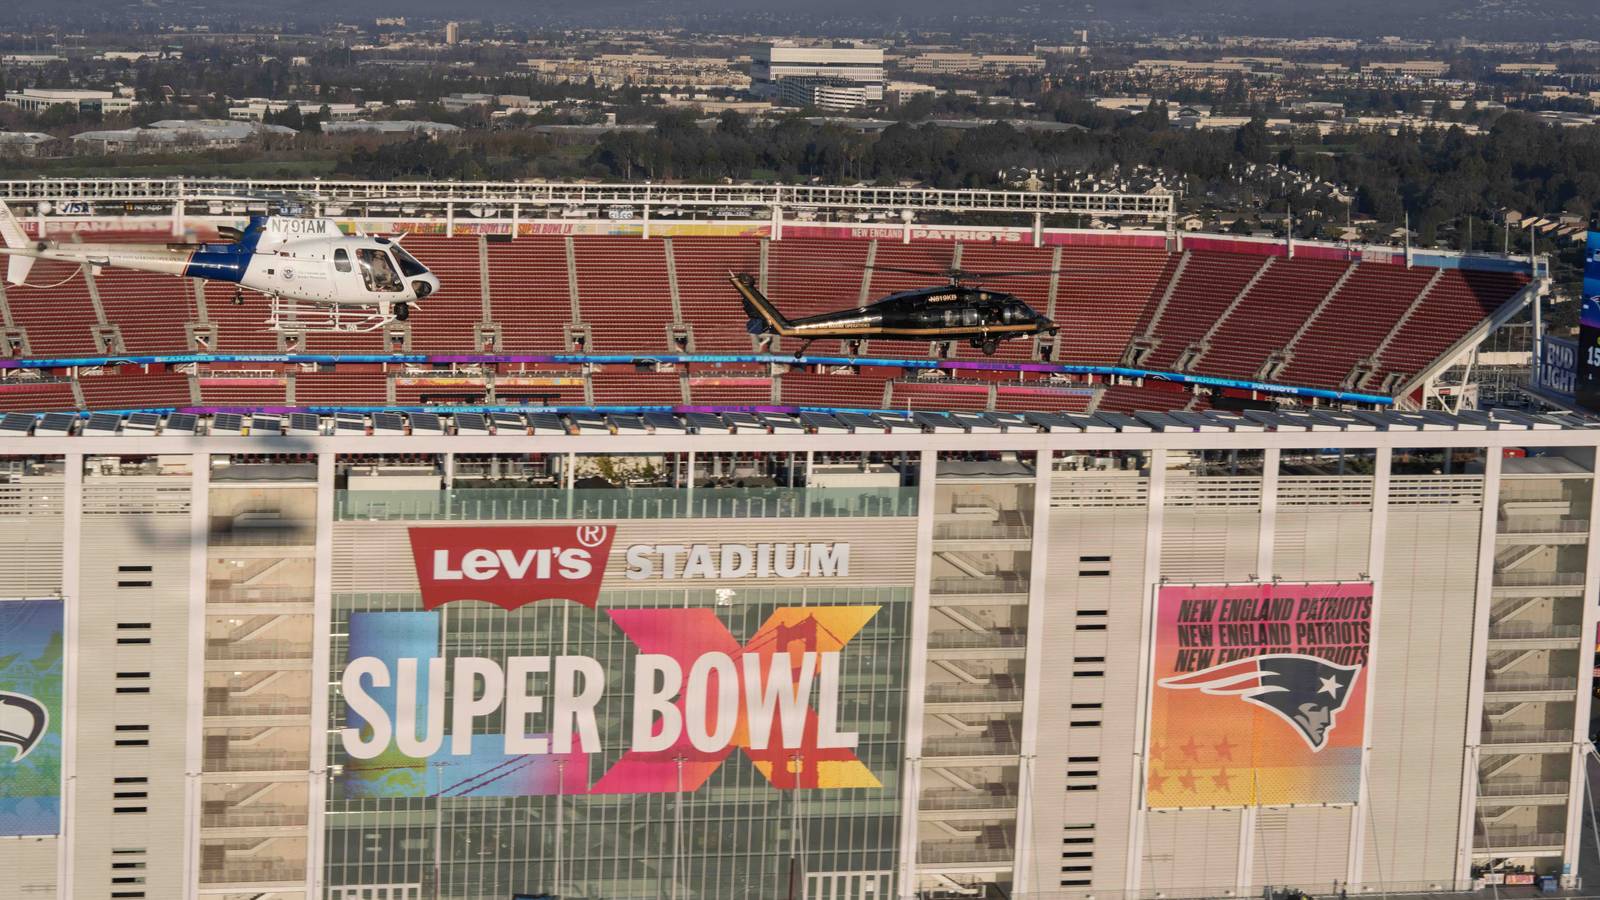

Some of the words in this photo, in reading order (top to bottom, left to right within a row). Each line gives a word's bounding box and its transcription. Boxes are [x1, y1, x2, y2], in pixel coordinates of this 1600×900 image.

[62, 202, 90, 213] VISA
[271, 218, 326, 234] N791AM
[454, 222, 478, 233] SUPER
[479, 222, 500, 233] BOWL
[518, 223, 541, 233] SUPER
[542, 223, 563, 233] BOWL
[851, 228, 868, 237] NEW
[870, 228, 902, 238] ENGLAND
[912, 229, 1021, 241] PATRIOTS
[1548, 343, 1573, 369] BUD
[1541, 364, 1577, 393] LIGHT
[625, 542, 850, 579] STADIUM
[1177, 599, 1218, 622] NEW
[1218, 598, 1295, 622] ENGLAND
[1297, 596, 1373, 620] PATRIOTS
[1177, 624, 1213, 647] NEW
[1218, 623, 1292, 647] ENGLAND
[1296, 621, 1370, 646] PATRIOTS
[1174, 649, 1215, 672] NEW
[340, 654, 605, 759] SUPER
[632, 651, 860, 754] BOWL
